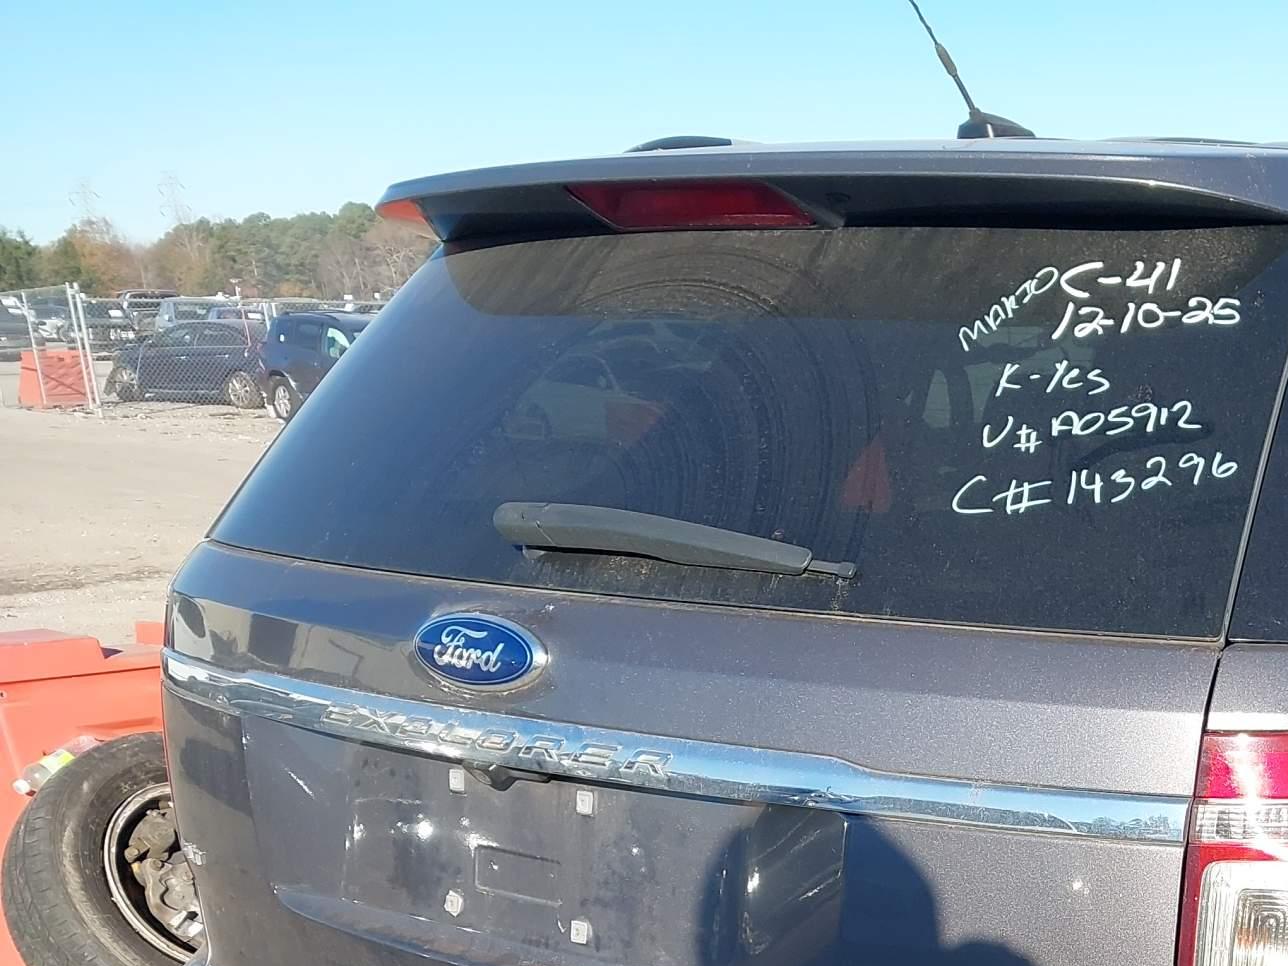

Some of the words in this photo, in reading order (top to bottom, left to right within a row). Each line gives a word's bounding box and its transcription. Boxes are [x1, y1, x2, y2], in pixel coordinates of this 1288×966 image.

[1059, 258, 1182, 298] C-41
[1051, 297, 1241, 340] 12-10-25
[951, 475, 1053, 515] C#
[1066, 451, 1239, 505] 143296
[433, 625, 505, 673] Ford
[320, 703, 673, 777] EXPLORER
